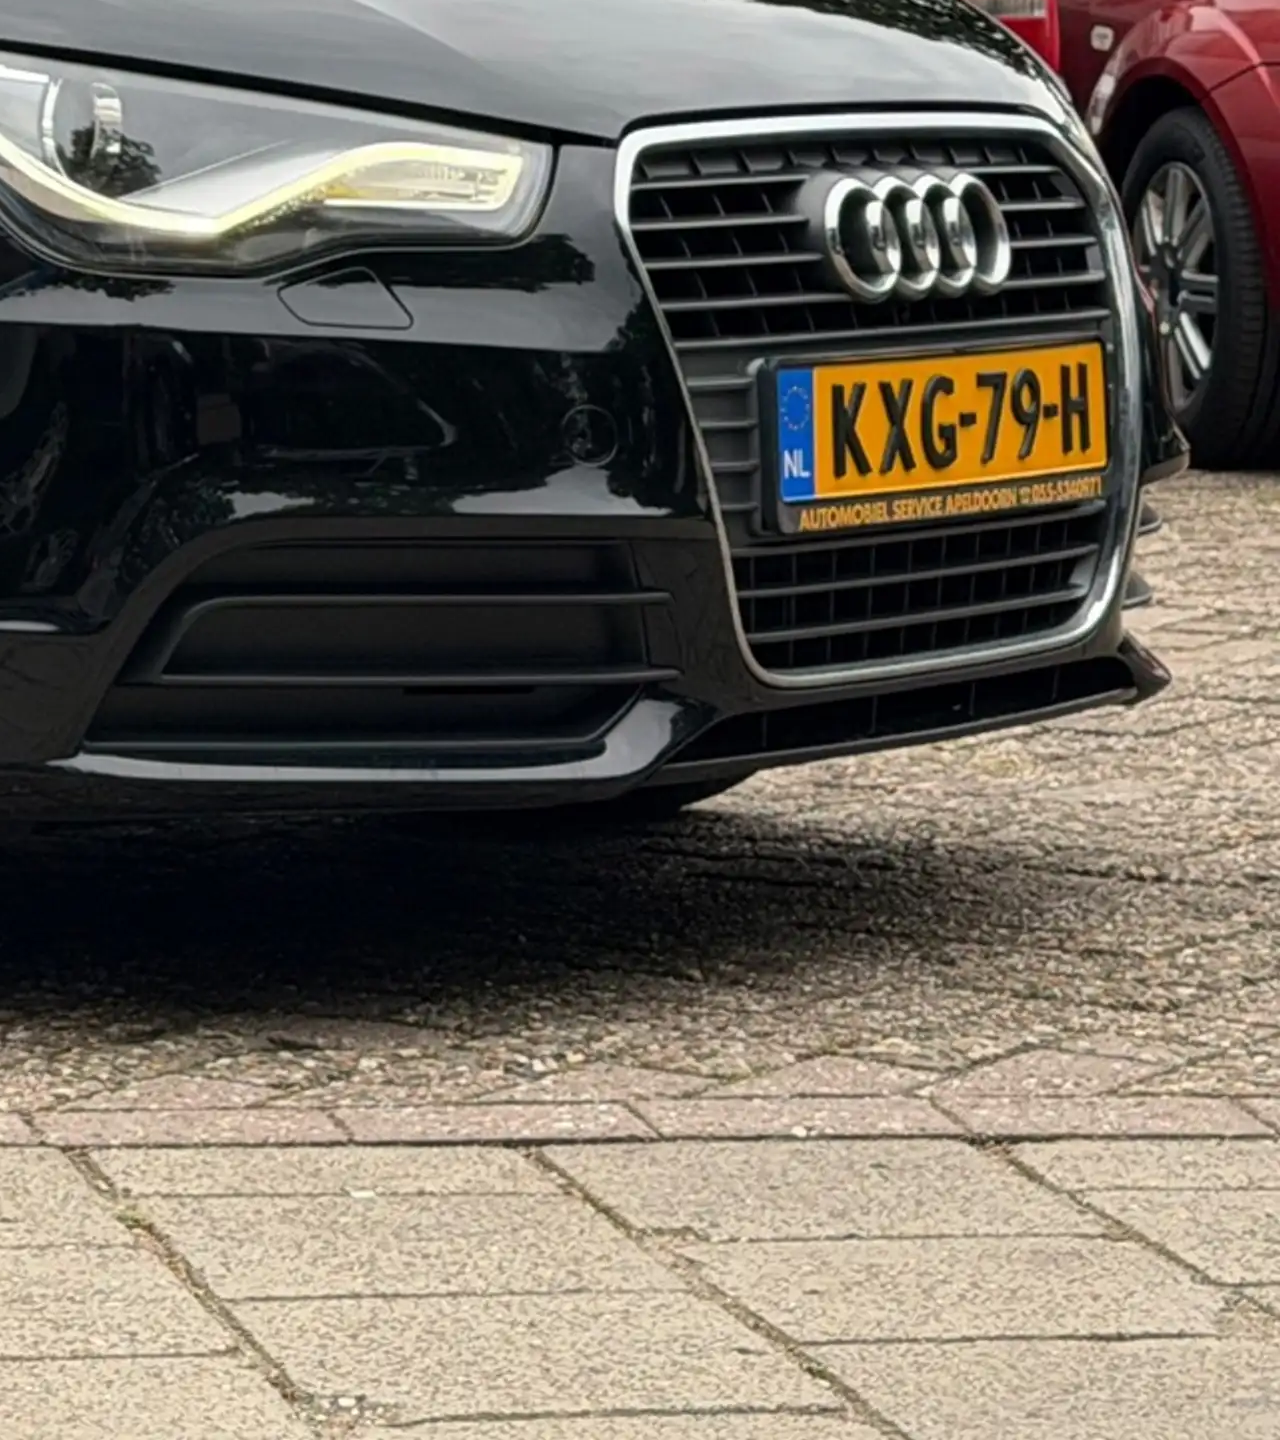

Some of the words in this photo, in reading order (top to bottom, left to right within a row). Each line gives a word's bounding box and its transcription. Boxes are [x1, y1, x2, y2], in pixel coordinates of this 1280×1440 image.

[831, 362, 1092, 481] KXG-79-H
[782, 448, 811, 480] NL
[798, 502, 890, 532] AUTOMOBIEL
[893, 495, 943, 520] SERVICE
